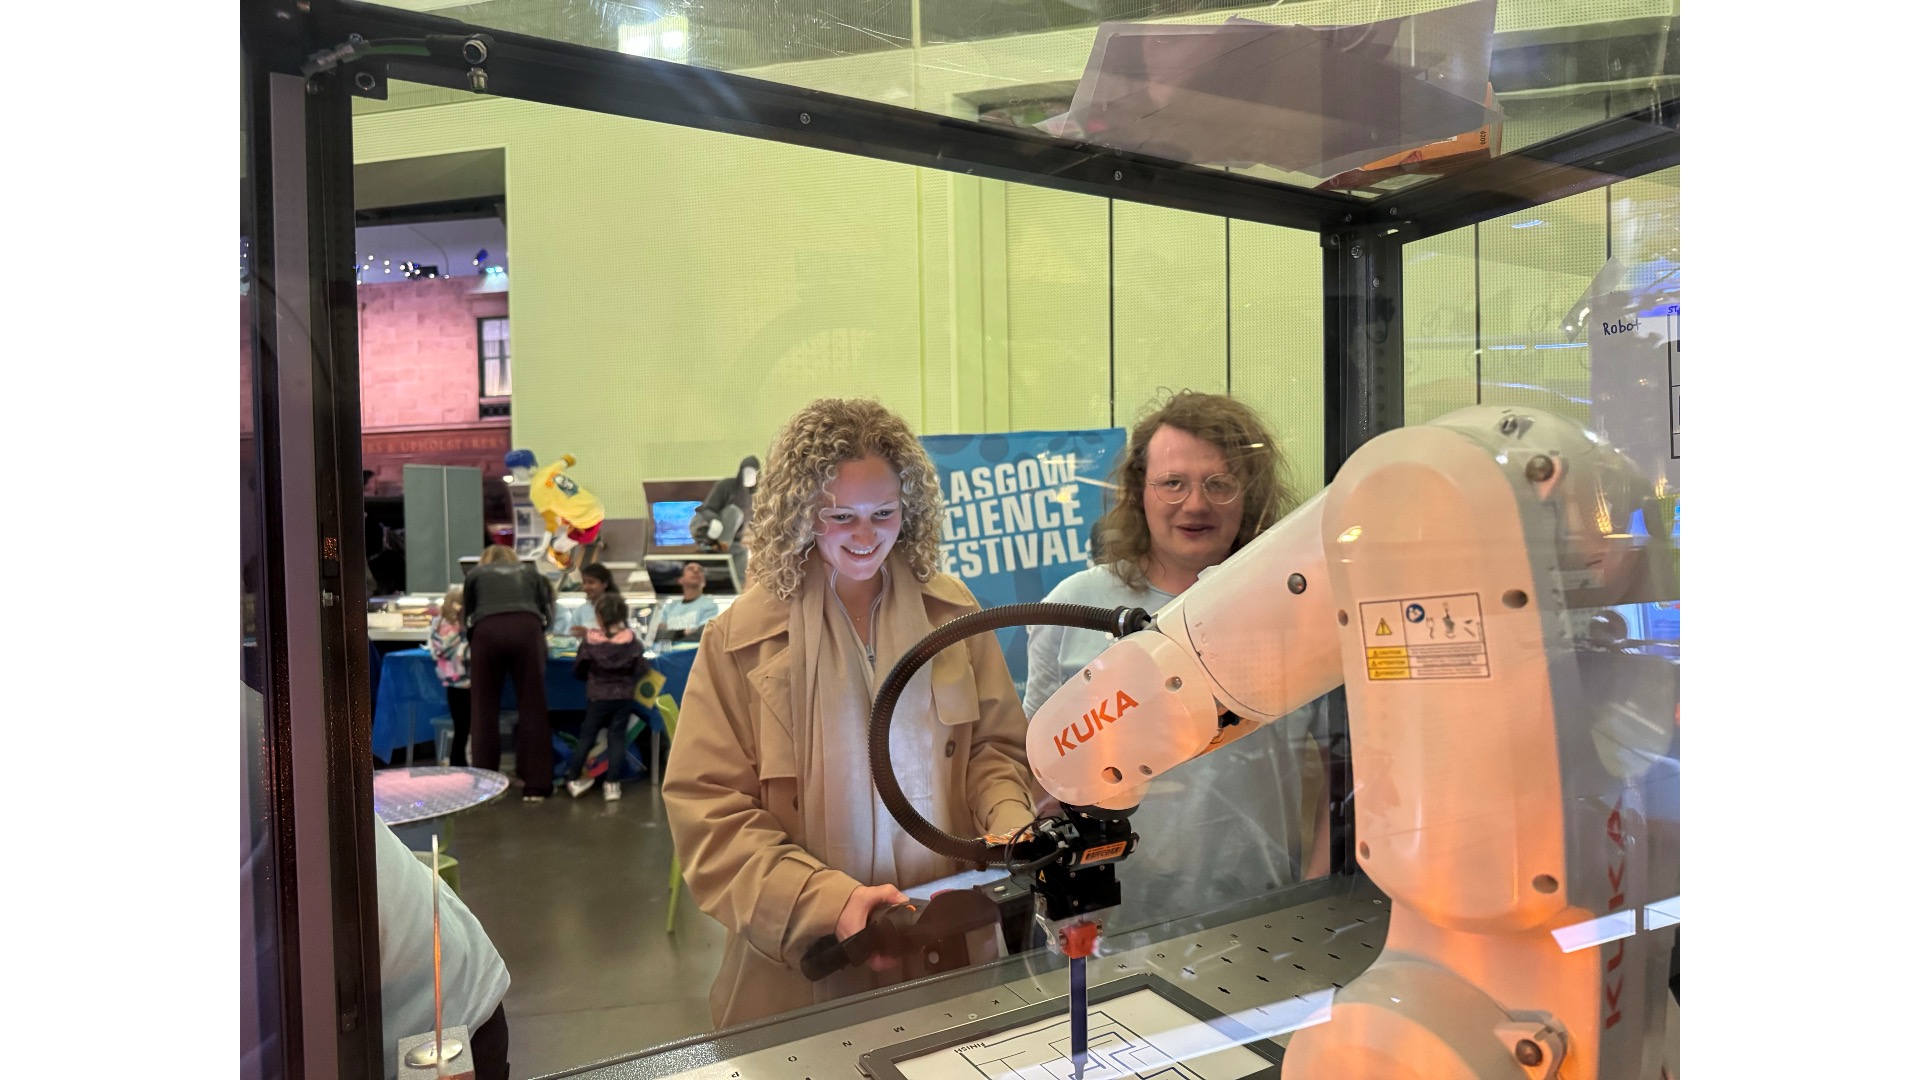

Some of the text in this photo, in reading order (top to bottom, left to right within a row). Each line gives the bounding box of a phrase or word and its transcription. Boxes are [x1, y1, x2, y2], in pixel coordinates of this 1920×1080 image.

[1602, 318, 1642, 336] Robot
[942, 453, 1077, 505] ASGOW
[942, 484, 1084, 541] CIENCE
[939, 528, 1088, 578] ESTIVAL
[1053, 690, 1139, 757] KUKA
[954, 1042, 986, 1054] FINISH
